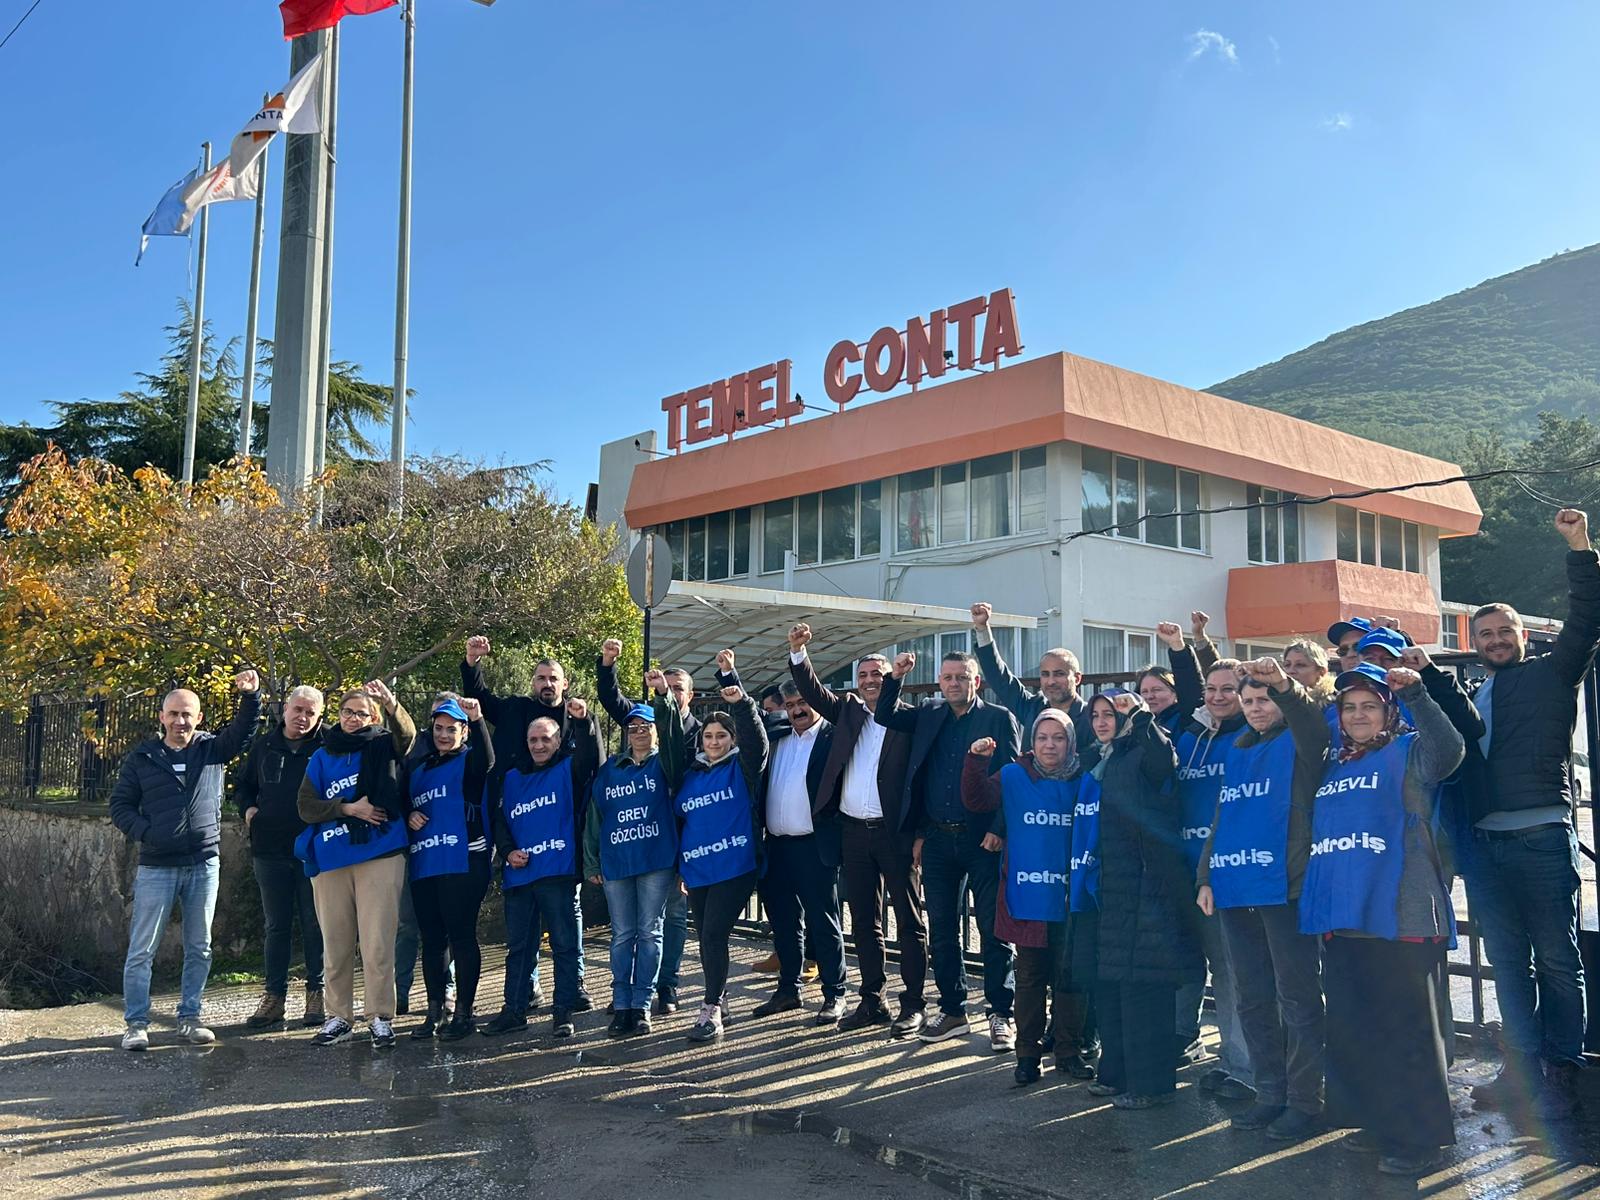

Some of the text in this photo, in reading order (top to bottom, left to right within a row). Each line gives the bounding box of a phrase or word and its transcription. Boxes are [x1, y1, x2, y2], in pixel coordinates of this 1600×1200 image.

[661, 287, 1022, 450] TEMEL CONTA
[326, 773, 359, 799] GÖRE
[411, 784, 447, 808] REVLİ
[605, 780, 637, 800] Petrol
[1219, 778, 1270, 803] ÖREVLİ
[681, 787, 734, 813] GÖREVLİ
[617, 806, 648, 823] GREV
[1023, 809, 1072, 826] GÖRE
[610, 821, 660, 845] GÖZCÜSÜ
[682, 834, 748, 862] petrol-iş
[1209, 848, 1274, 868] etrol-iş
